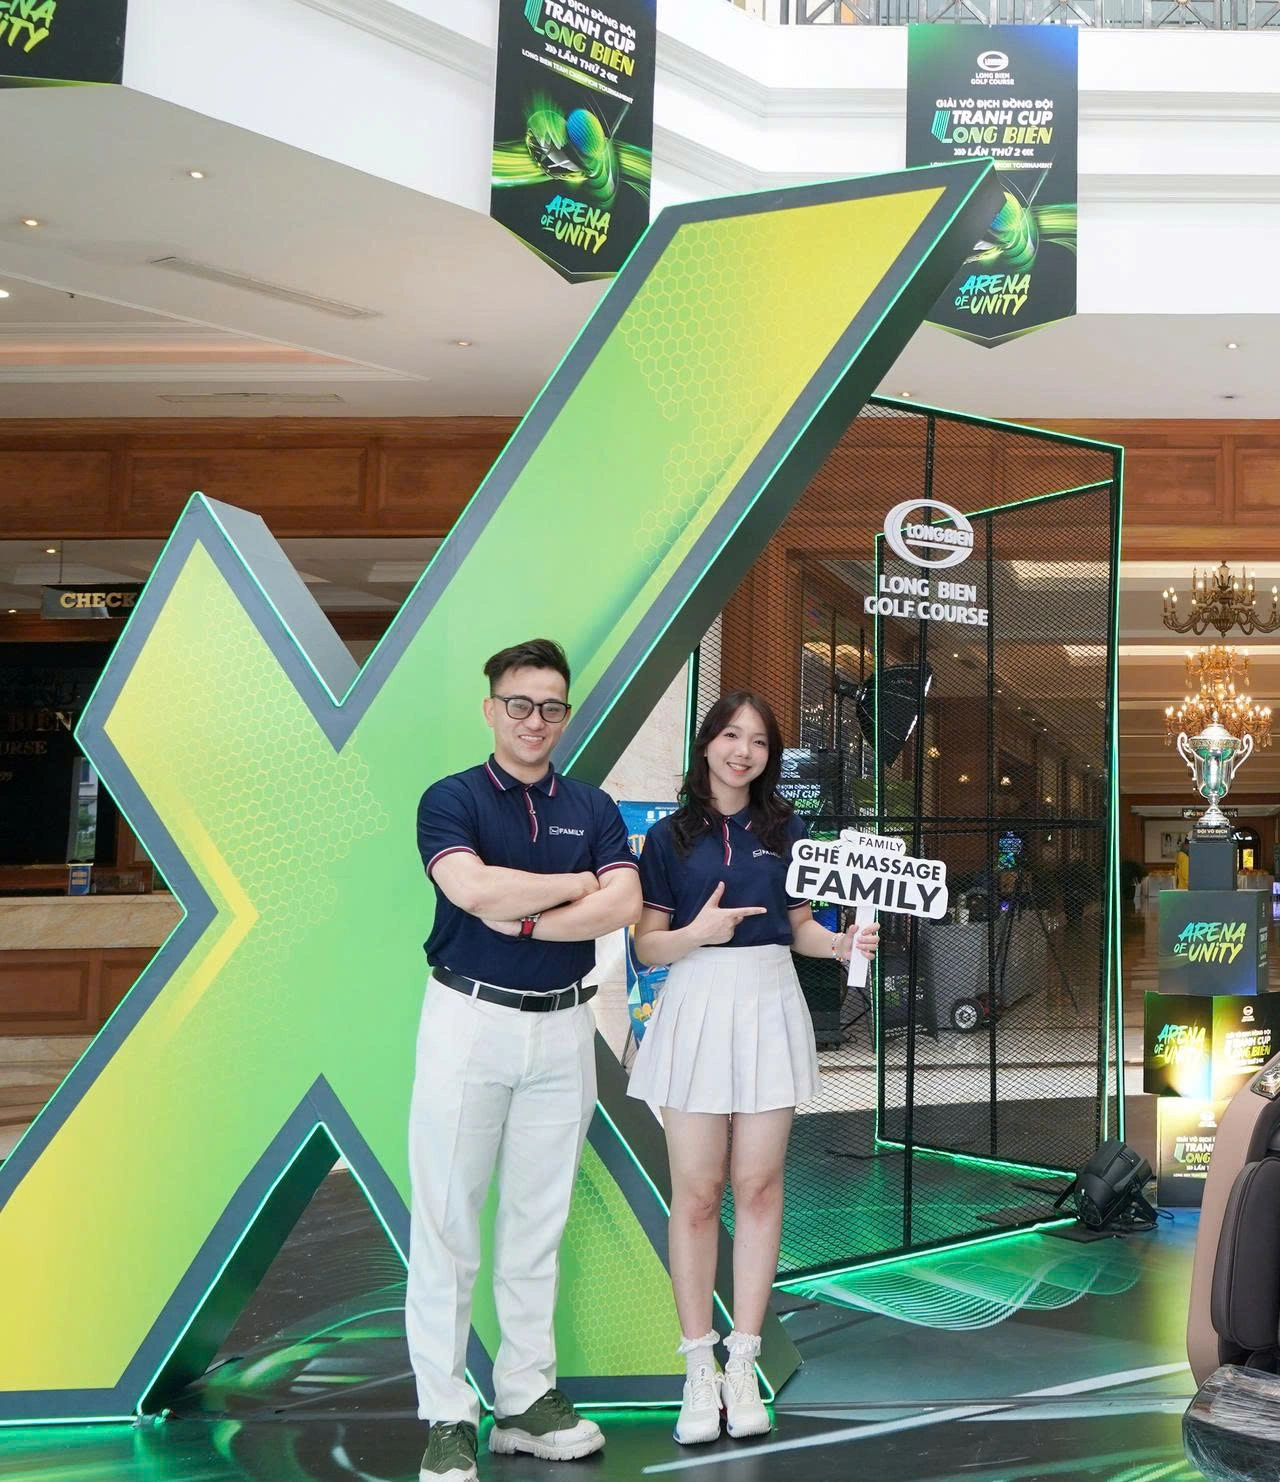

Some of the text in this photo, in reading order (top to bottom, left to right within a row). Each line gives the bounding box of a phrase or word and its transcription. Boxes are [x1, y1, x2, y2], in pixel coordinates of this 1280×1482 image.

[544, 1, 636, 53] TRANH CUP
[524, 0, 635, 77] LONG BIÊN
[600, 69, 607, 79] 2
[936, 97, 957, 108] GIẢI
[959, 98, 975, 108] VÔ
[1002, 97, 1033, 109] ĐỒNG
[1035, 98, 1053, 110] ĐỘI
[931, 111, 1053, 144] LONG BIÊN
[952, 110, 1053, 126] TRANH CUP
[1014, 148, 1020, 156] 2
[540, 214, 554, 227] OF
[545, 194, 611, 235] ARENA
[959, 273, 1031, 295] ARENA
[954, 295, 969, 307] OF
[879, 574, 977, 602] LONG BIEN
[864, 596, 989, 626] GOLF COURSE
[559, 827, 584, 836] FAMILY
[858, 836, 904, 855] FAMILY
[846, 852, 941, 882] MASSAGE
[795, 865, 942, 914] FAMILY
[1178, 922, 1247, 943] ARENA
[1174, 943, 1187, 953] OF
[1185, 1143, 1214, 1152] TRAN
